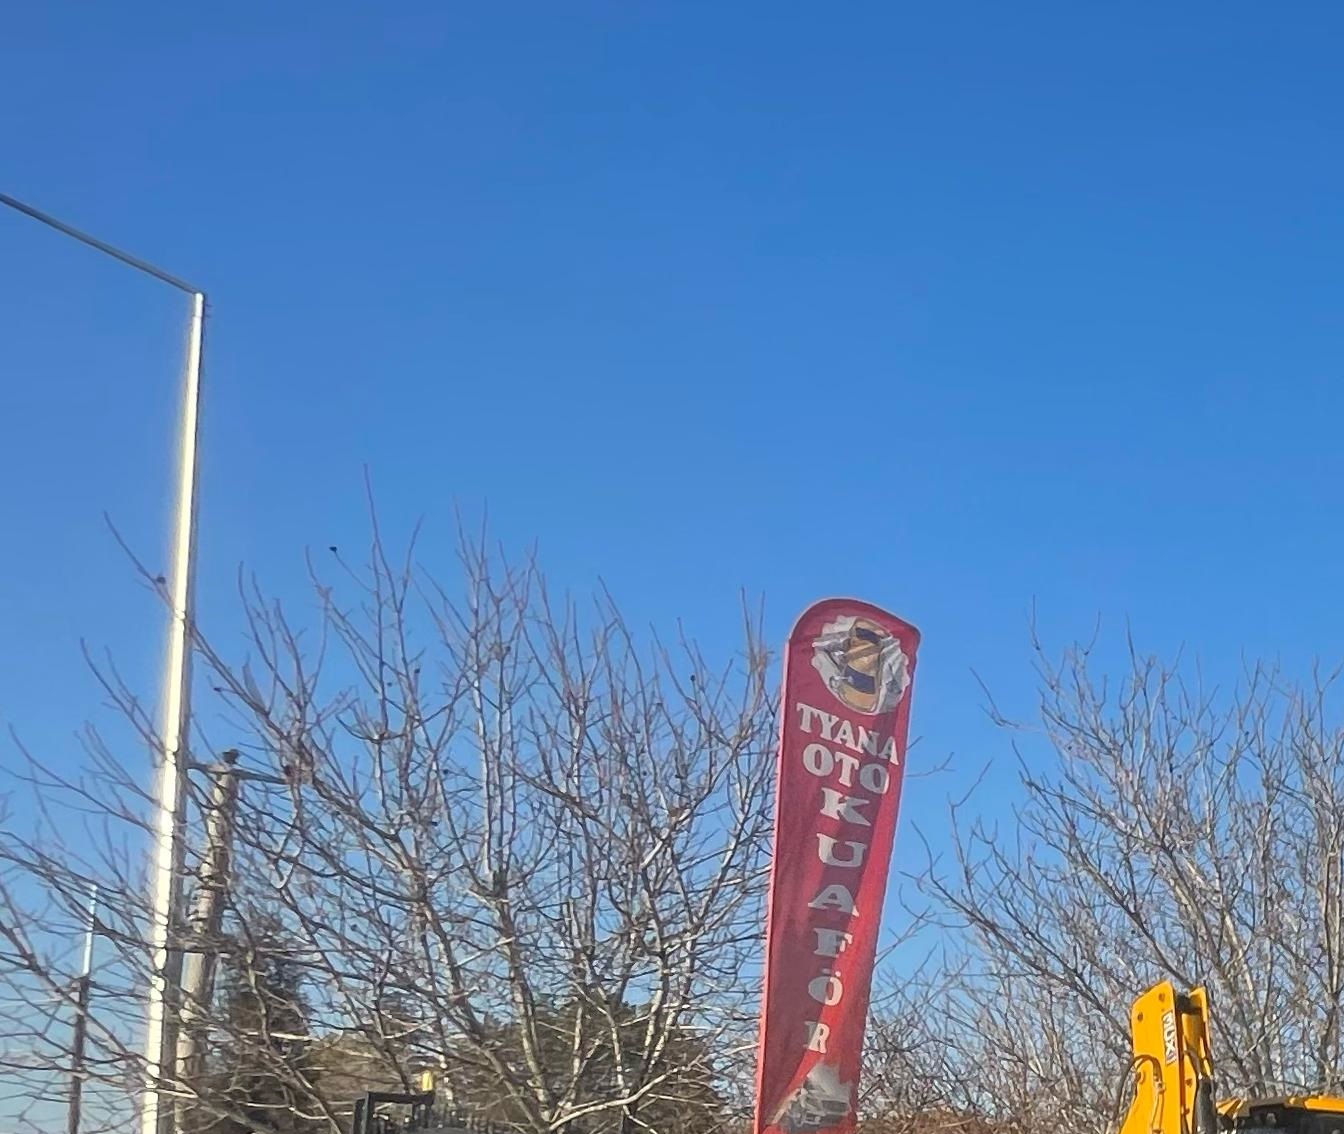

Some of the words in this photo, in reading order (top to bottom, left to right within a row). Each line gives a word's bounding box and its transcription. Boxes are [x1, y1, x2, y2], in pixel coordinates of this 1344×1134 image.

[797, 702, 899, 767] TYANA
[802, 743, 889, 795] OTO
[804, 787, 871, 1055] KUAFÖR
